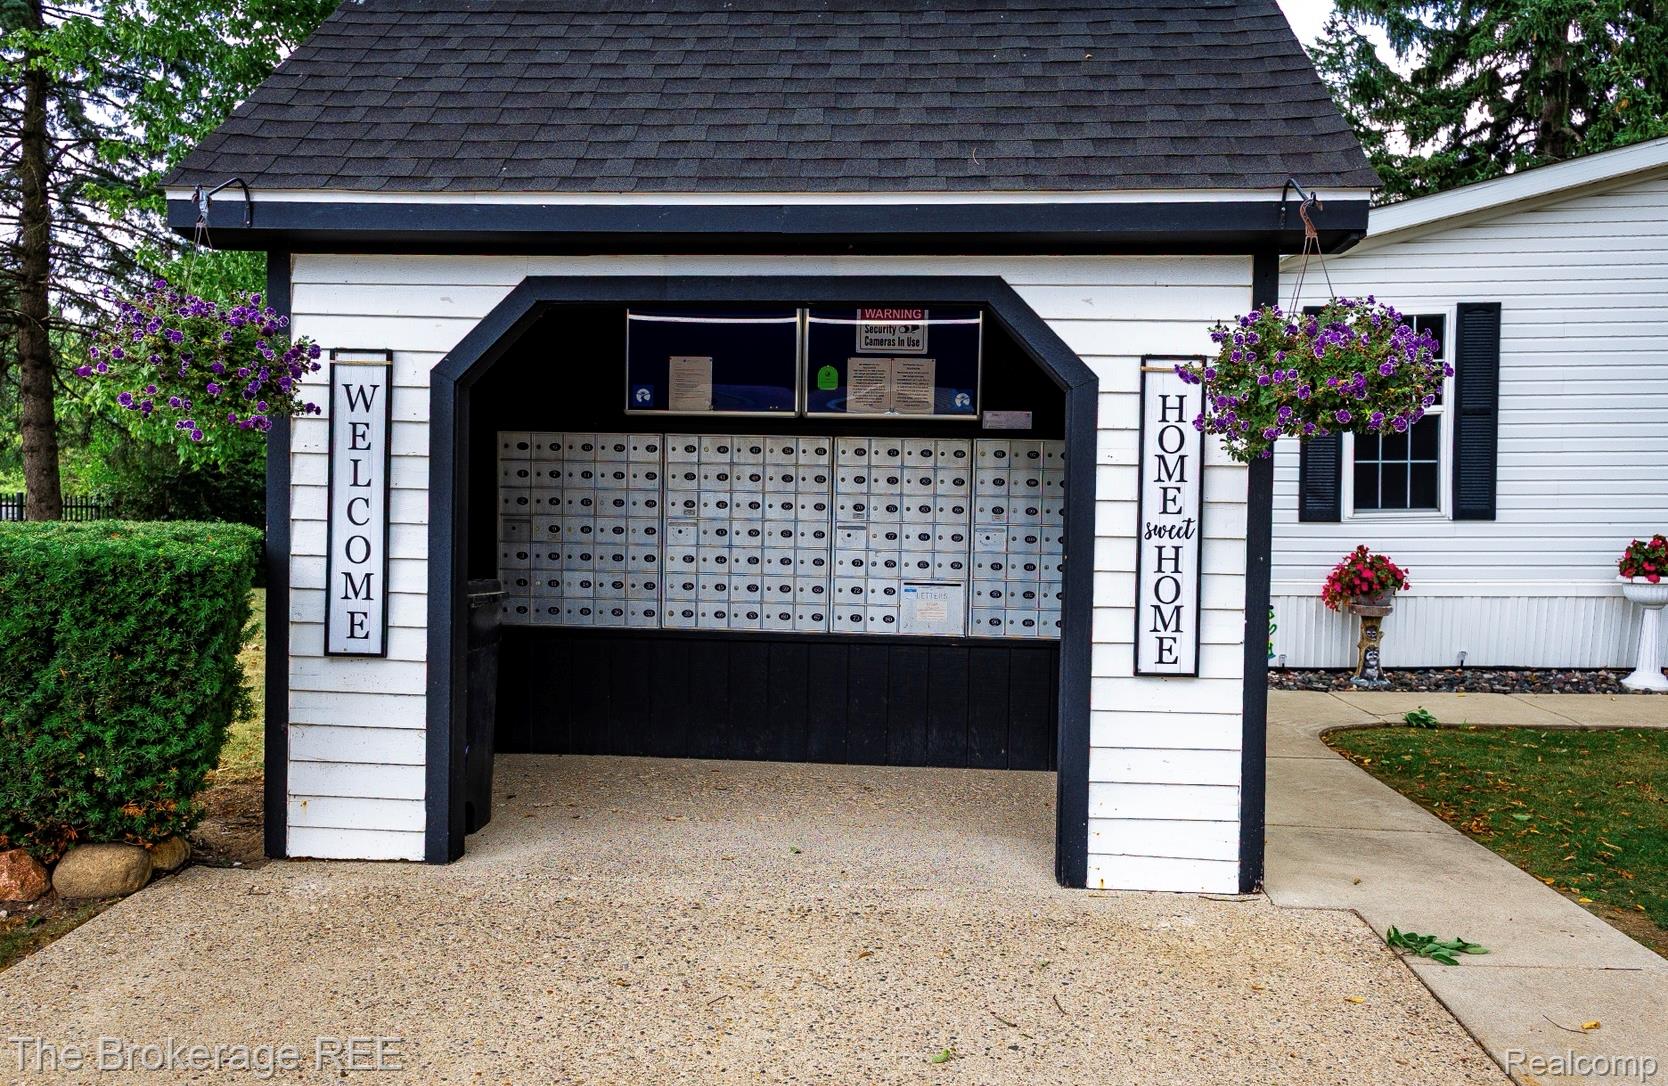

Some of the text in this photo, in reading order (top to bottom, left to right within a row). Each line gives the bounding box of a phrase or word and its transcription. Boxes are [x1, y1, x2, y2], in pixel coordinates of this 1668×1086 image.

[864, 309, 922, 319] WARNING
[864, 324, 897, 336] Security
[864, 336, 920, 347] Cameras In Use
[340, 383, 380, 640] WELCOME
[1144, 394, 1196, 666] HOME sweet HOME
